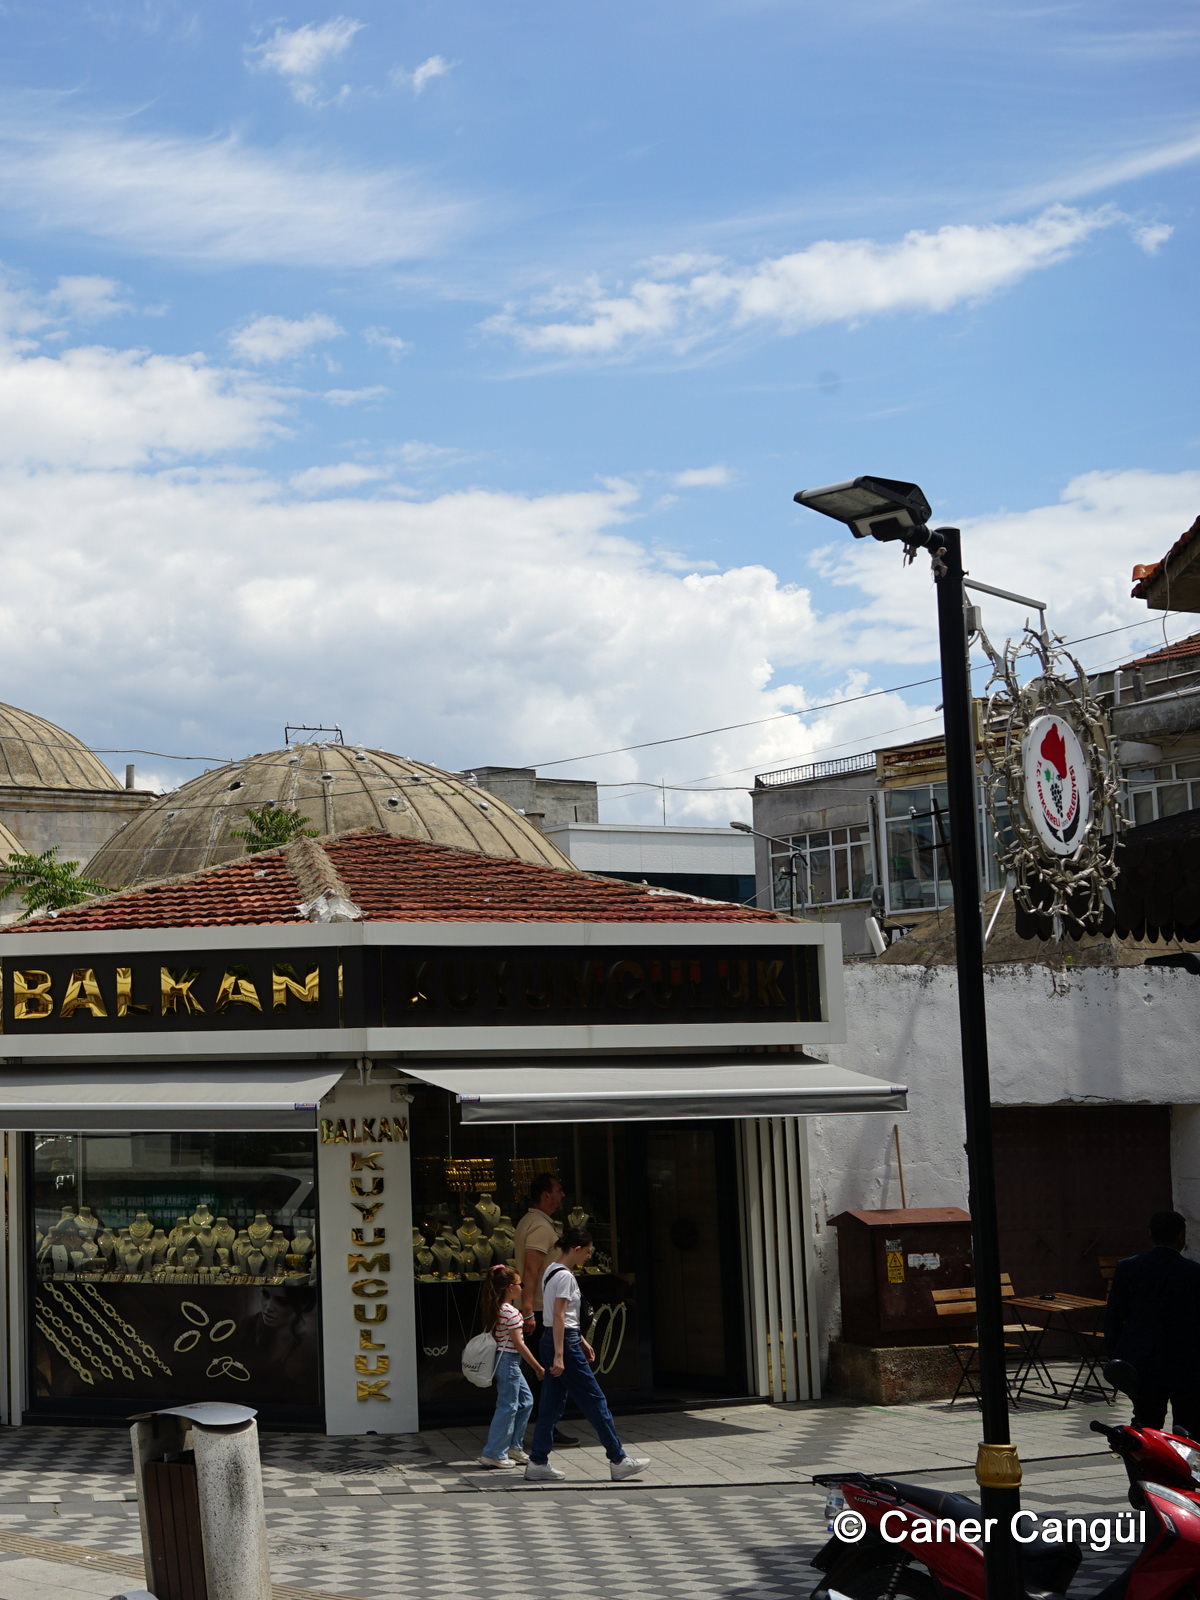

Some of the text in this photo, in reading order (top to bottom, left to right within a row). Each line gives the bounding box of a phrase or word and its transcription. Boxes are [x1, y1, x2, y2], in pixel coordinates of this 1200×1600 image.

[13, 962, 320, 1019] BALKAN
[320, 1117, 409, 1144] BALKAN
[347, 1151, 392, 1402] KUYUMCULUK
